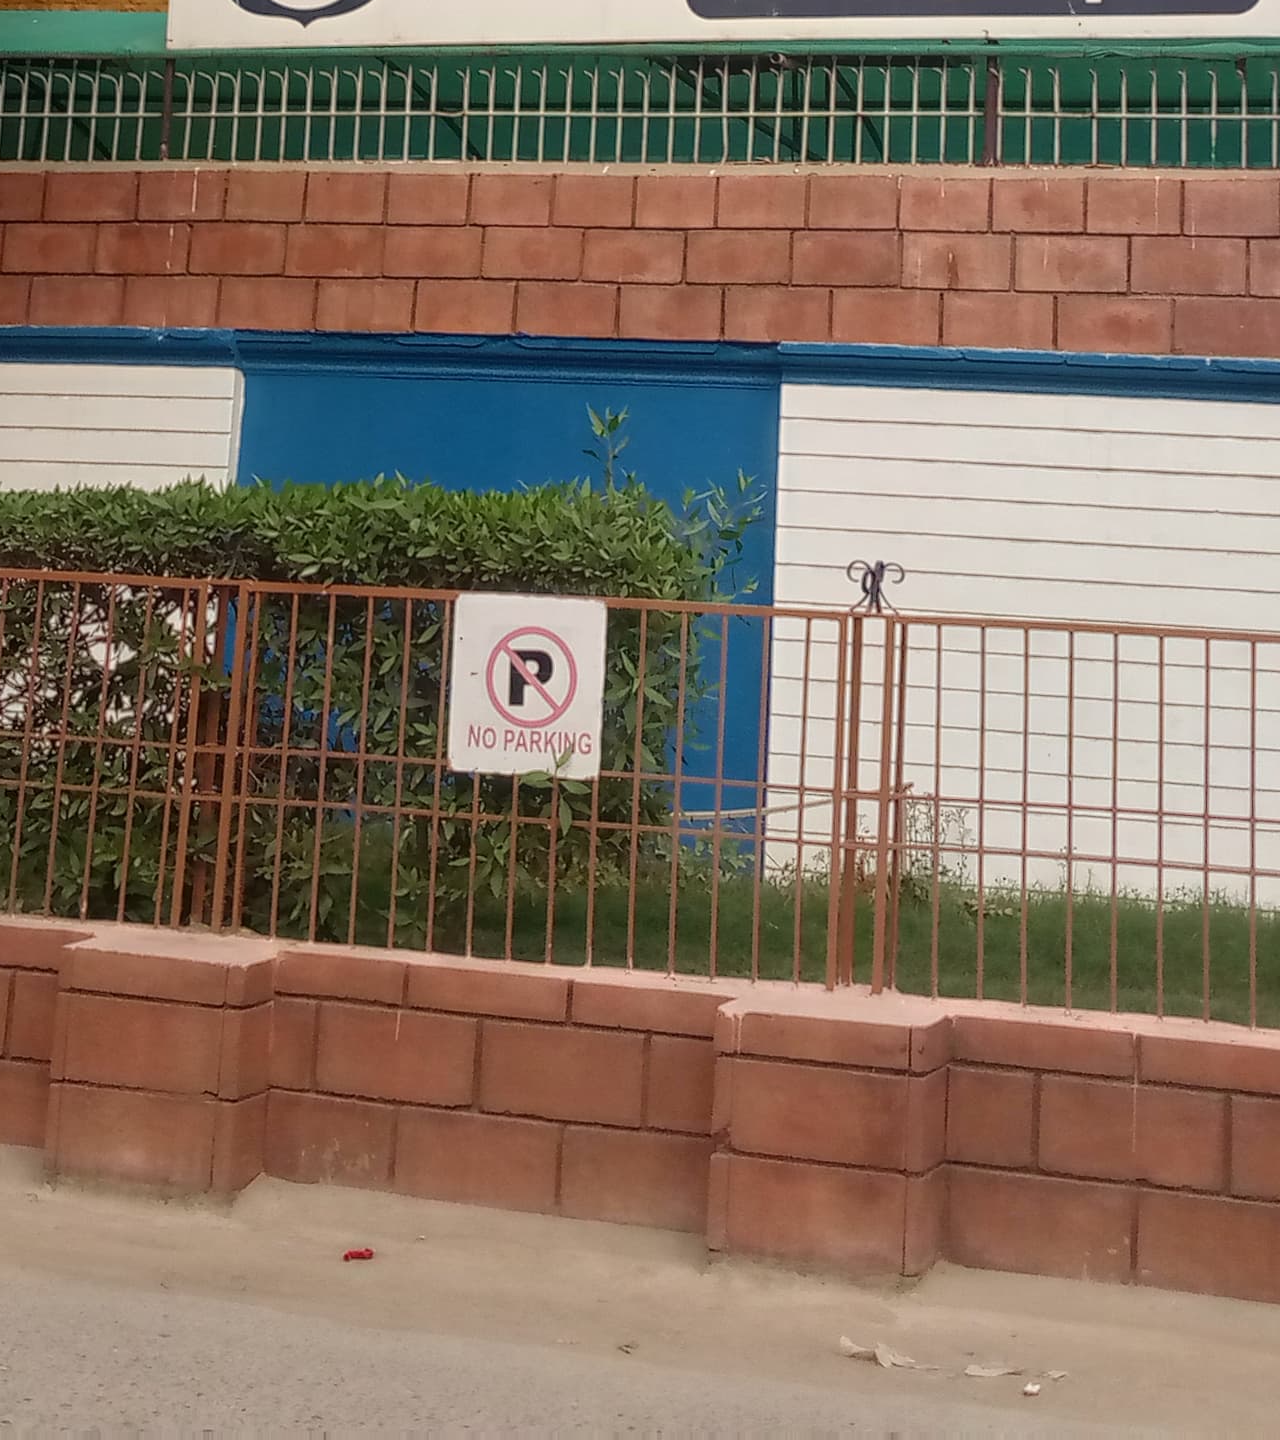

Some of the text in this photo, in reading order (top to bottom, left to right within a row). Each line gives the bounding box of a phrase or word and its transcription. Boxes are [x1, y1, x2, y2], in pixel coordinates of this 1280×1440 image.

[509, 649, 553, 706] P
[467, 724, 592, 755] NO PARKING
